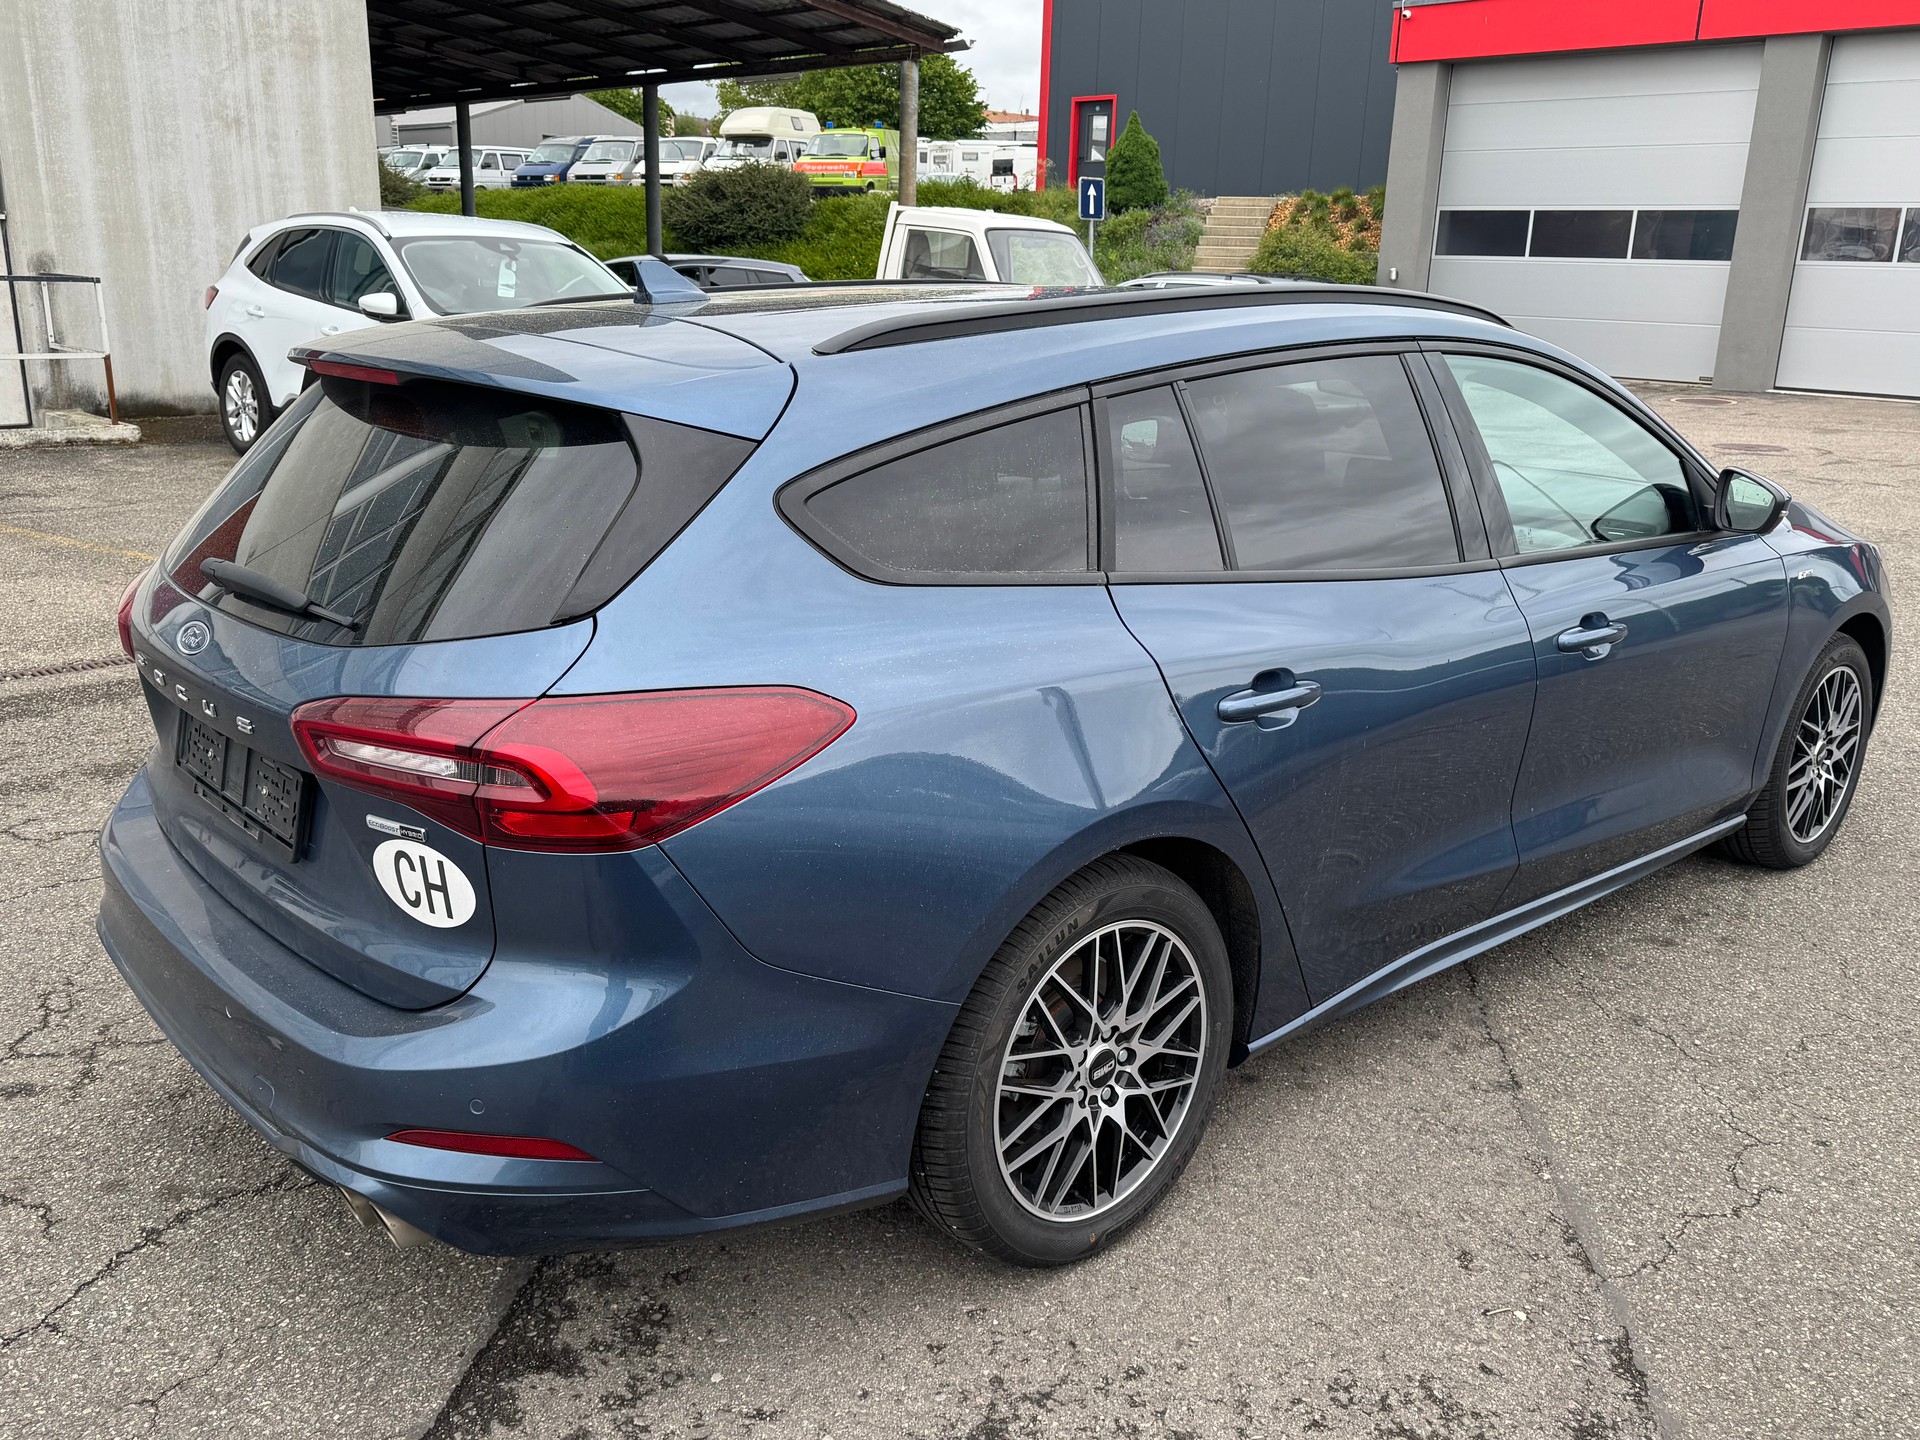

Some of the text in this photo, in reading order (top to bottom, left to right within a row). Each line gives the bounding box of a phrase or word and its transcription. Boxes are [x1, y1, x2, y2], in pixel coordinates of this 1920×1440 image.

[137, 653, 256, 735] FOCUS
[400, 829, 422, 840] HYBRID
[394, 849, 454, 920] CH
[1016, 917, 1079, 994] SAILUN
